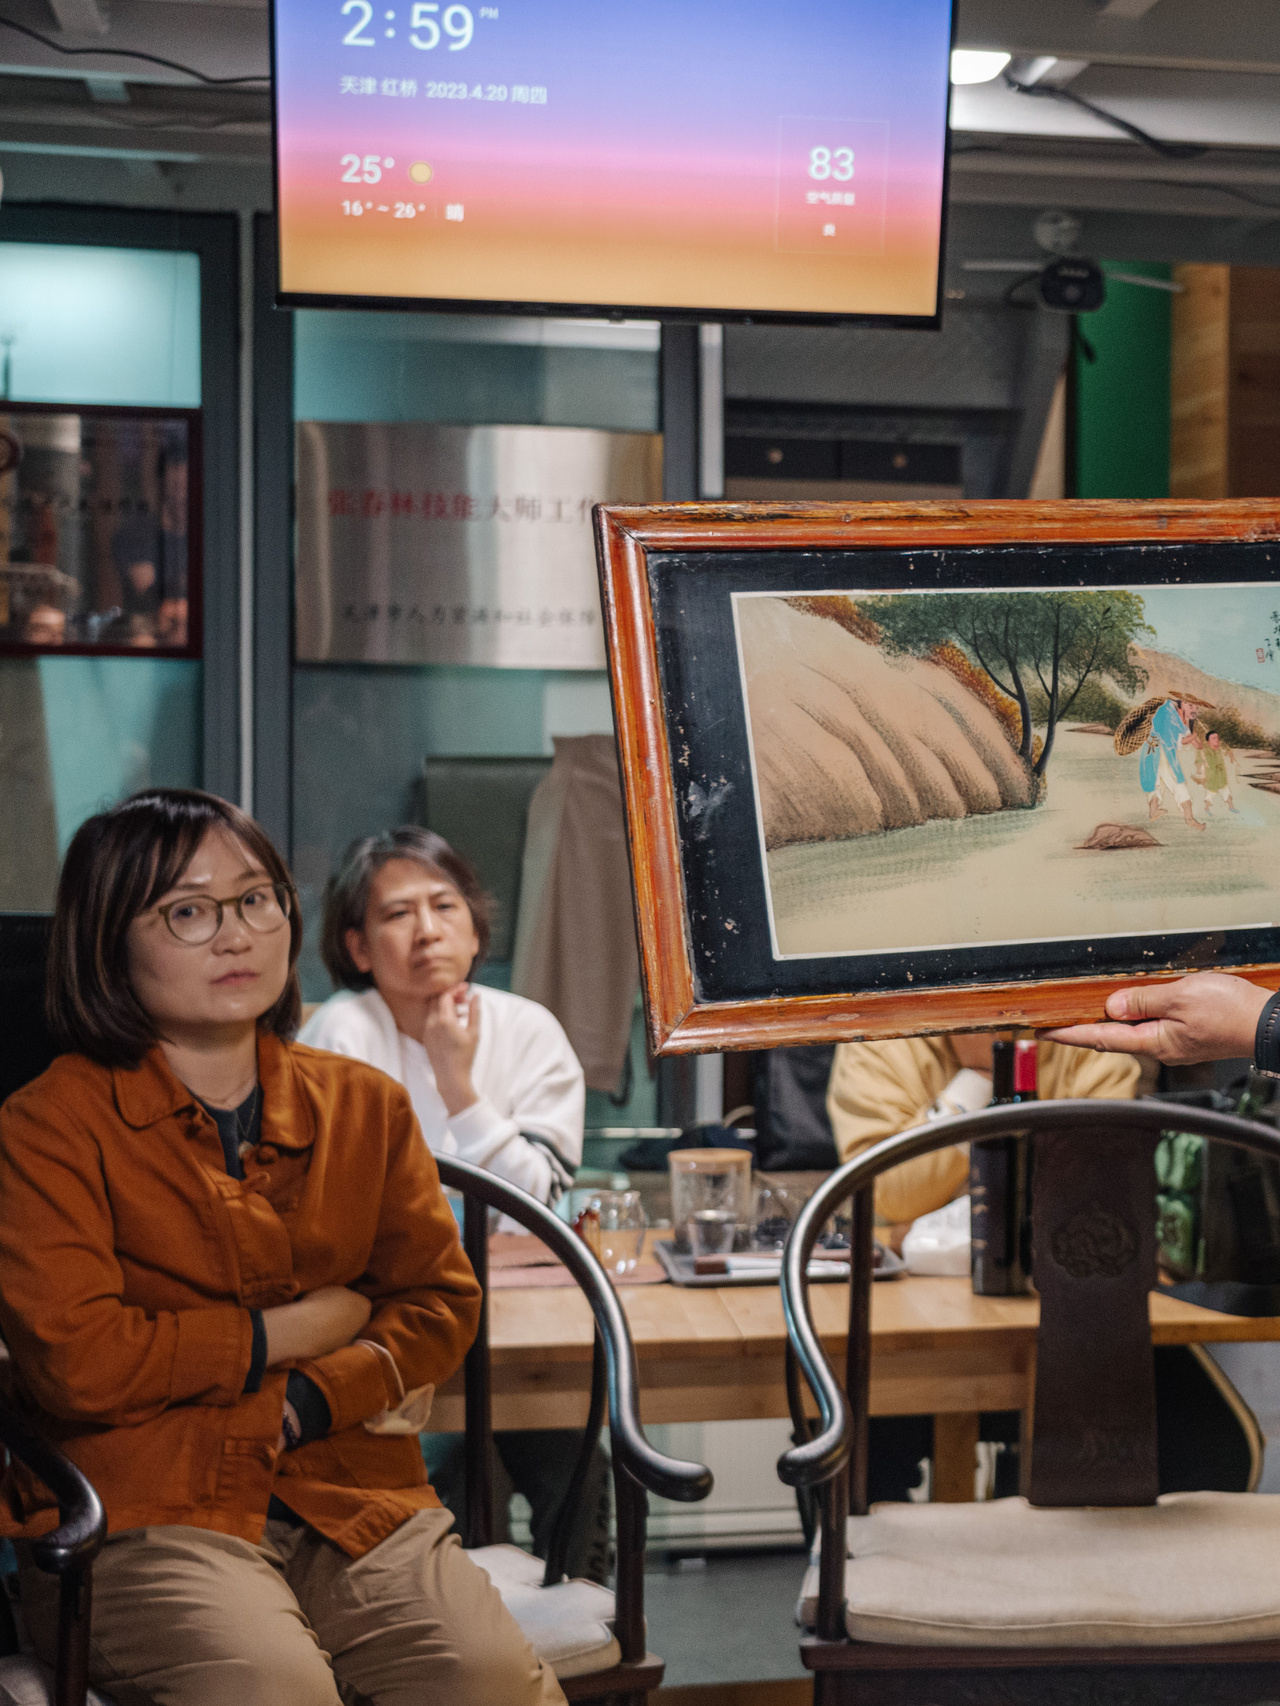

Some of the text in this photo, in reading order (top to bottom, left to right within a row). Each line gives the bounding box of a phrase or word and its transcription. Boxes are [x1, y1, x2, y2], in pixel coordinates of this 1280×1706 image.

[341, 0, 499, 51] 2:59 PM
[340, 76, 548, 105] 天津 红桥 2023.4.20 周四
[808, 146, 855, 181] 83
